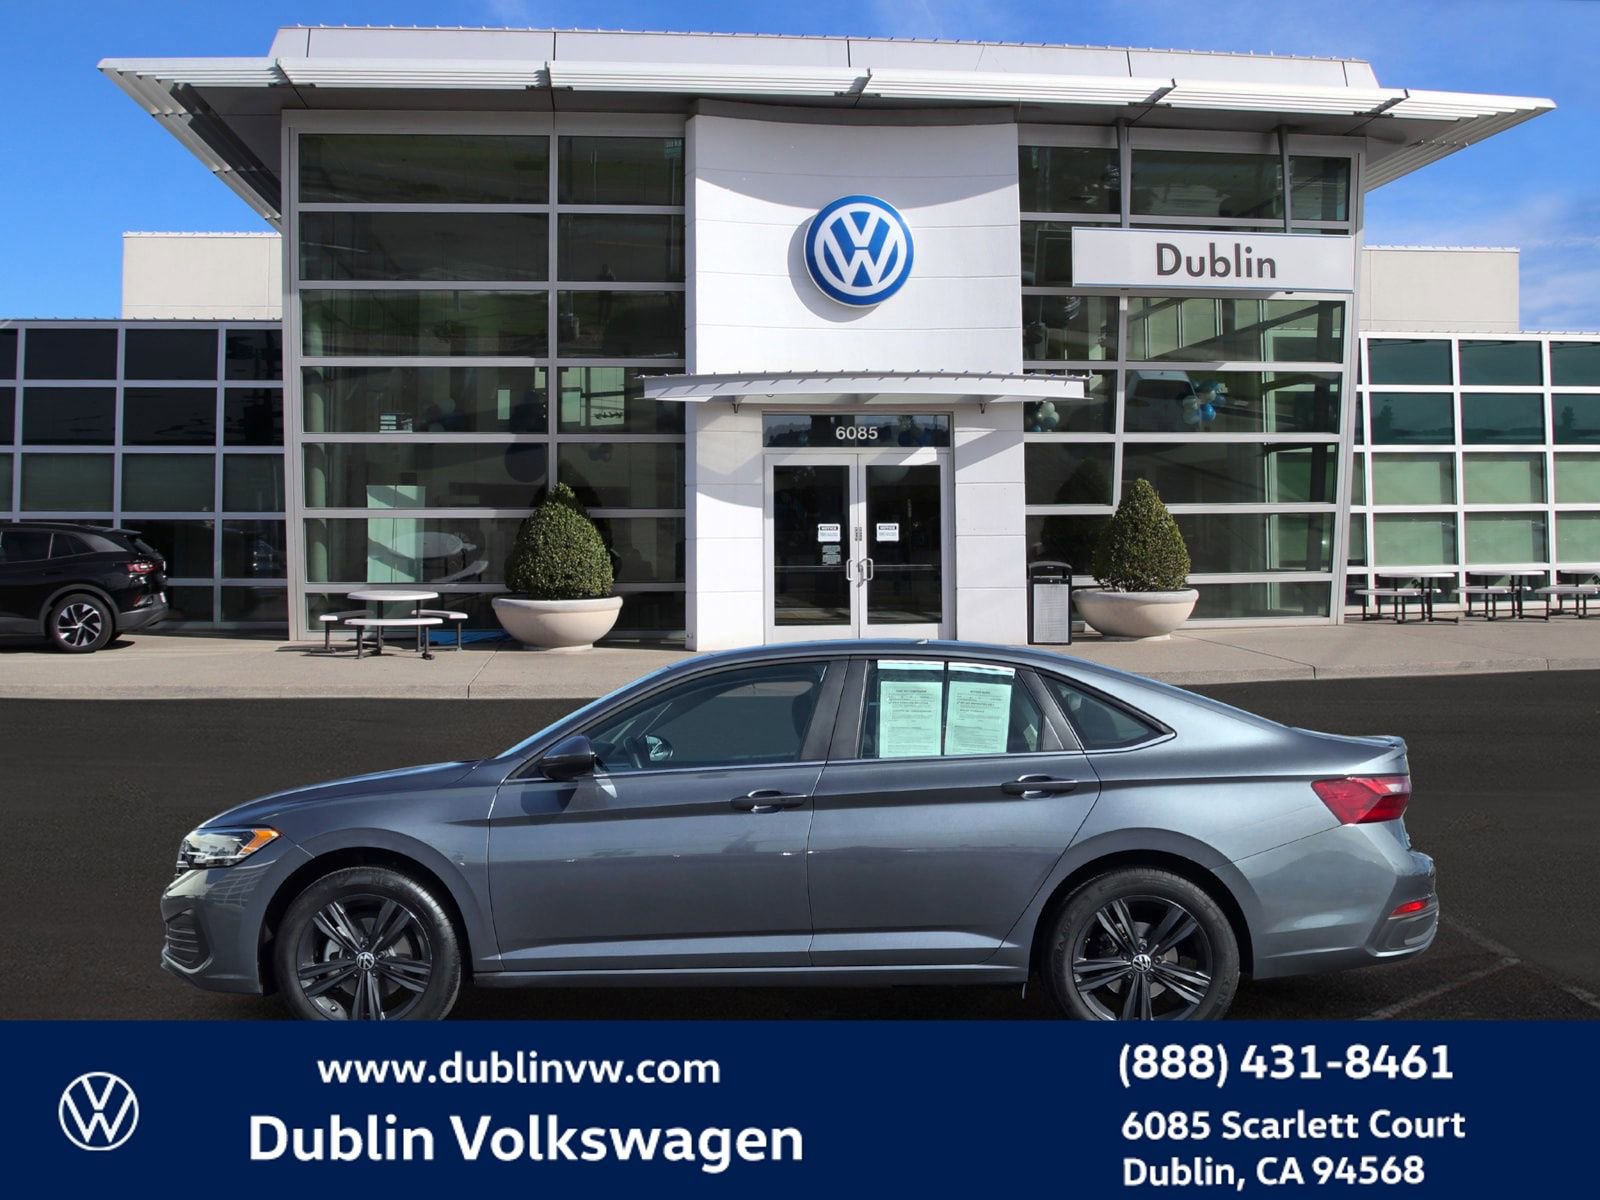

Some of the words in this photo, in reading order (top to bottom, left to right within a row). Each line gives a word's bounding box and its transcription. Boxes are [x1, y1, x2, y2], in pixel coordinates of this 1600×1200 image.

[812, 201, 909, 298] VW
[1156, 242, 1276, 279] Dublin
[835, 426, 878, 440] 6085
